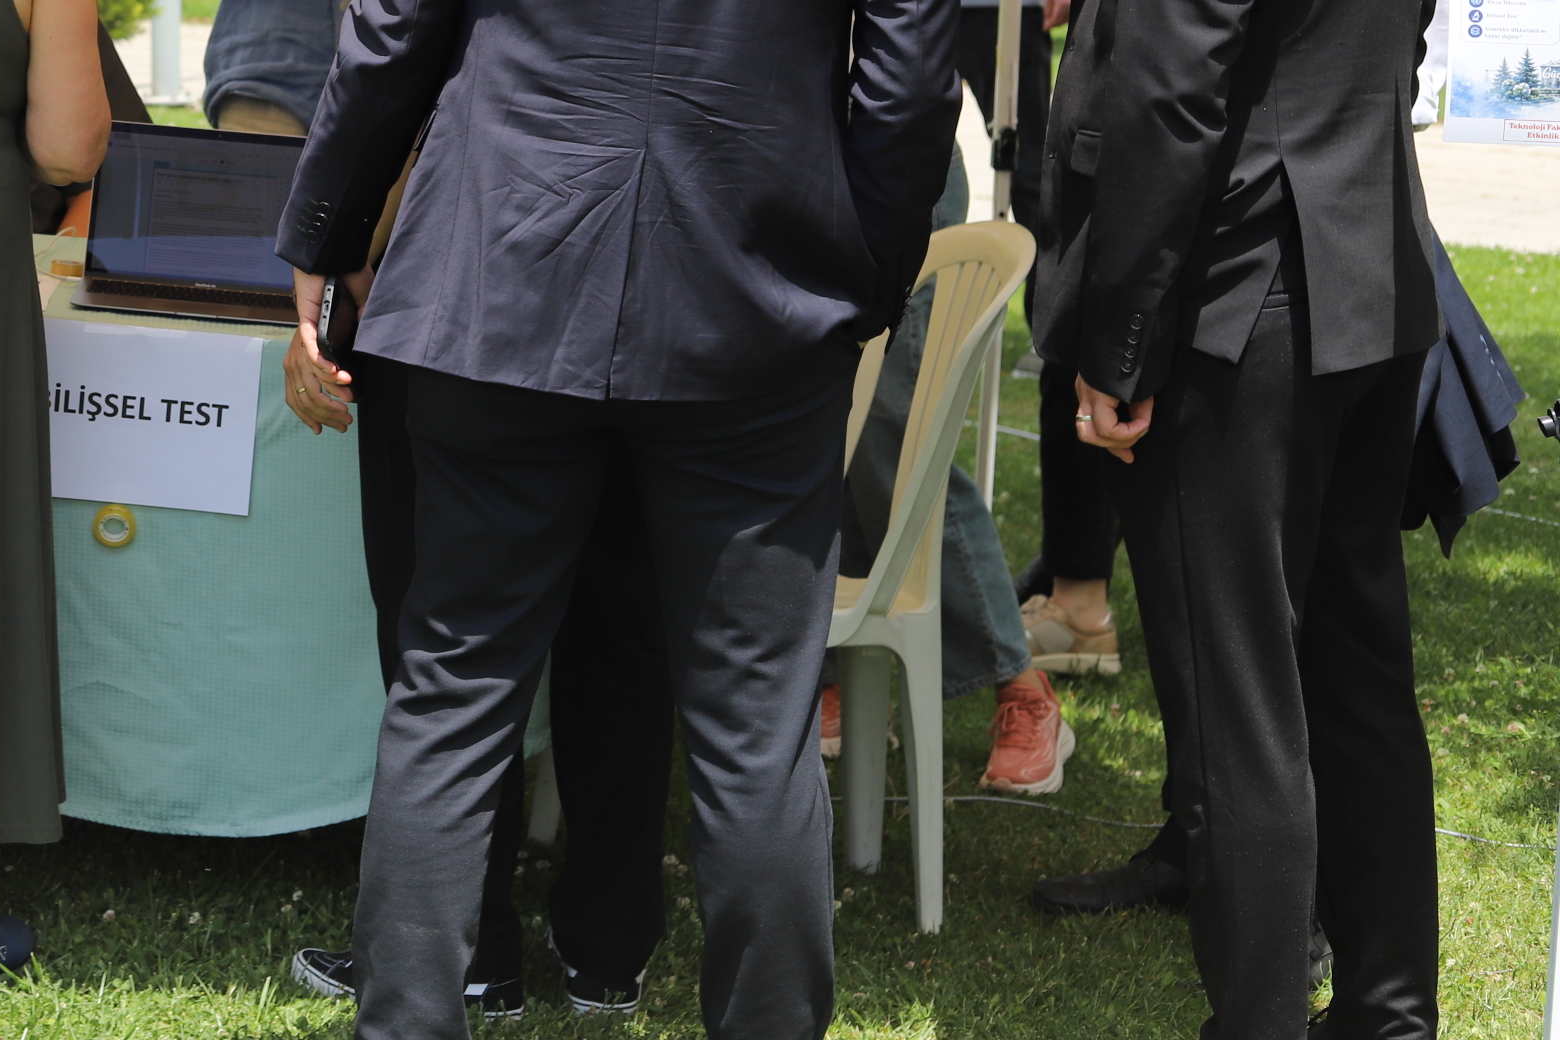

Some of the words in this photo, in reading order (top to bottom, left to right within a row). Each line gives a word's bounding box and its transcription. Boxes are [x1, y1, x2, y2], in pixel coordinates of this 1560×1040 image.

[1509, 123, 1546, 131] Teknoloji
[48, 382, 152, 422] İLİŞSEL
[160, 398, 230, 428] TEST
